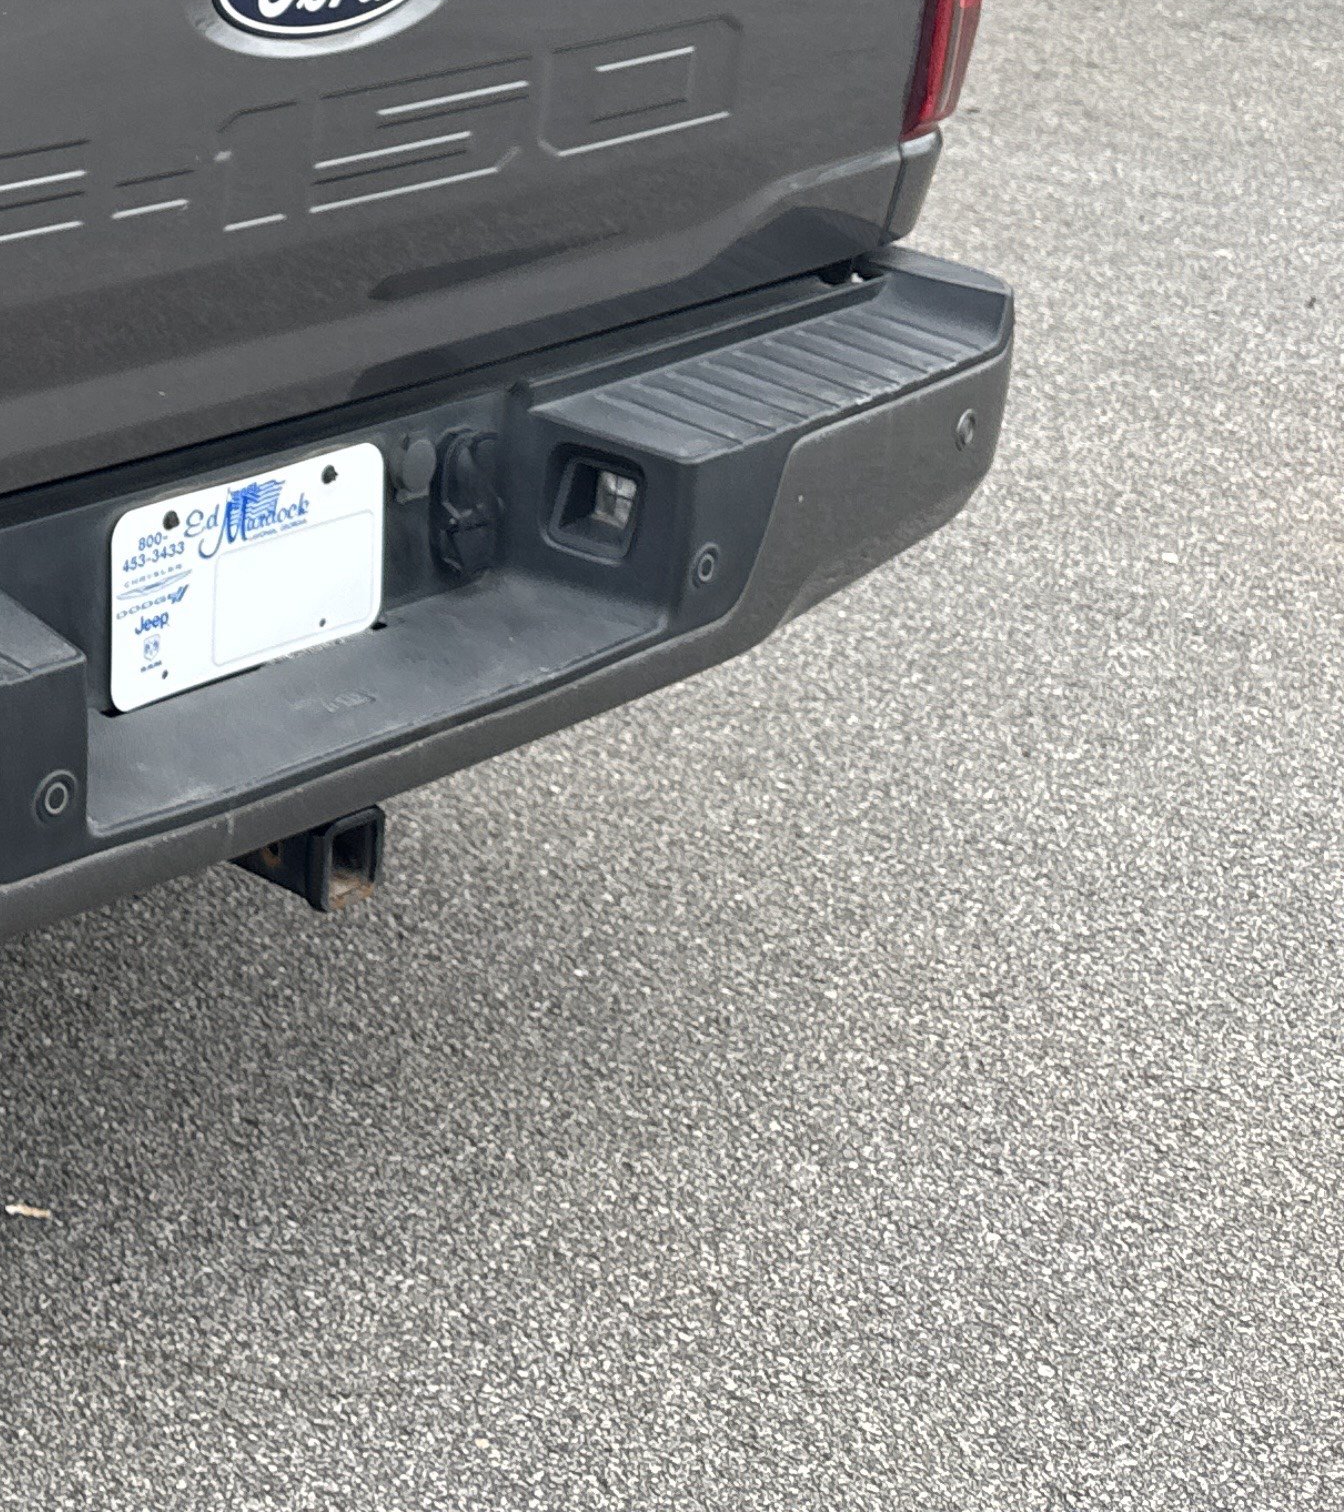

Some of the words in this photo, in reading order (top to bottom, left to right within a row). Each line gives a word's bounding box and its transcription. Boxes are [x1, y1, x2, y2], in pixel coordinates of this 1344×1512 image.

[183, 503, 219, 538] Ed
[138, 531, 168, 551] 800-
[123, 541, 185, 572] 453-3433
[135, 611, 169, 635] Jeep
